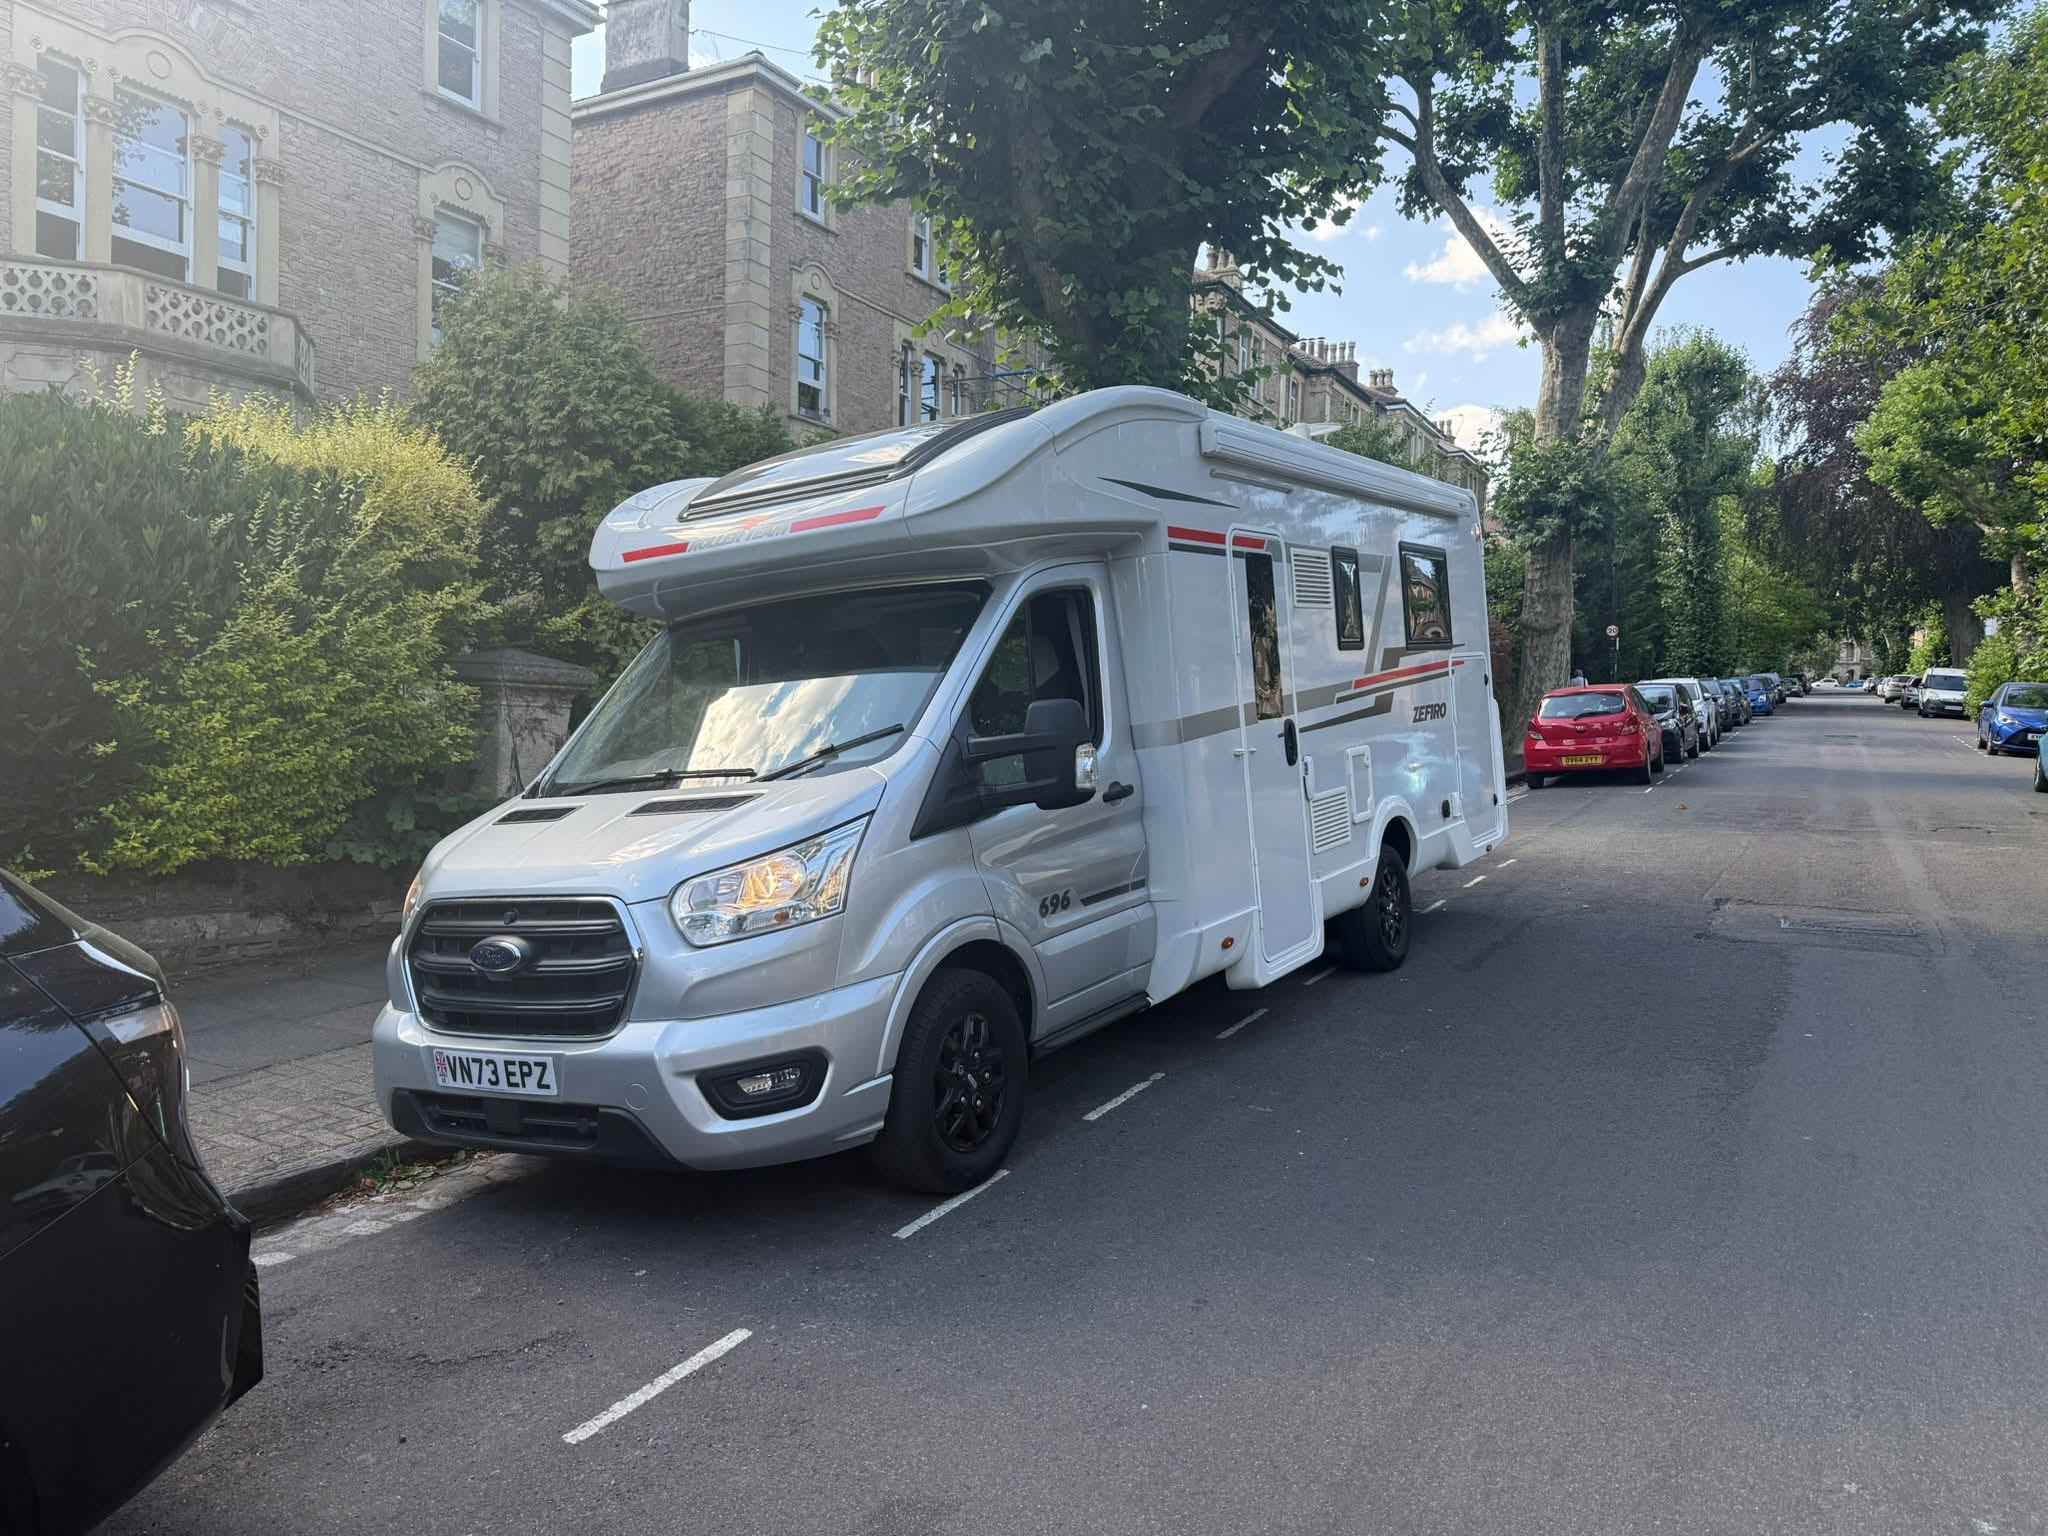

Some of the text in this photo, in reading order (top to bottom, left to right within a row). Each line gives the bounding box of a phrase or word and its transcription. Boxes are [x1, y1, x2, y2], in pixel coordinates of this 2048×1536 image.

[1412, 702, 1447, 723] ZEFIRO
[1039, 889, 1071, 918] 696
[446, 1055, 551, 1090] VN73 EPZ
